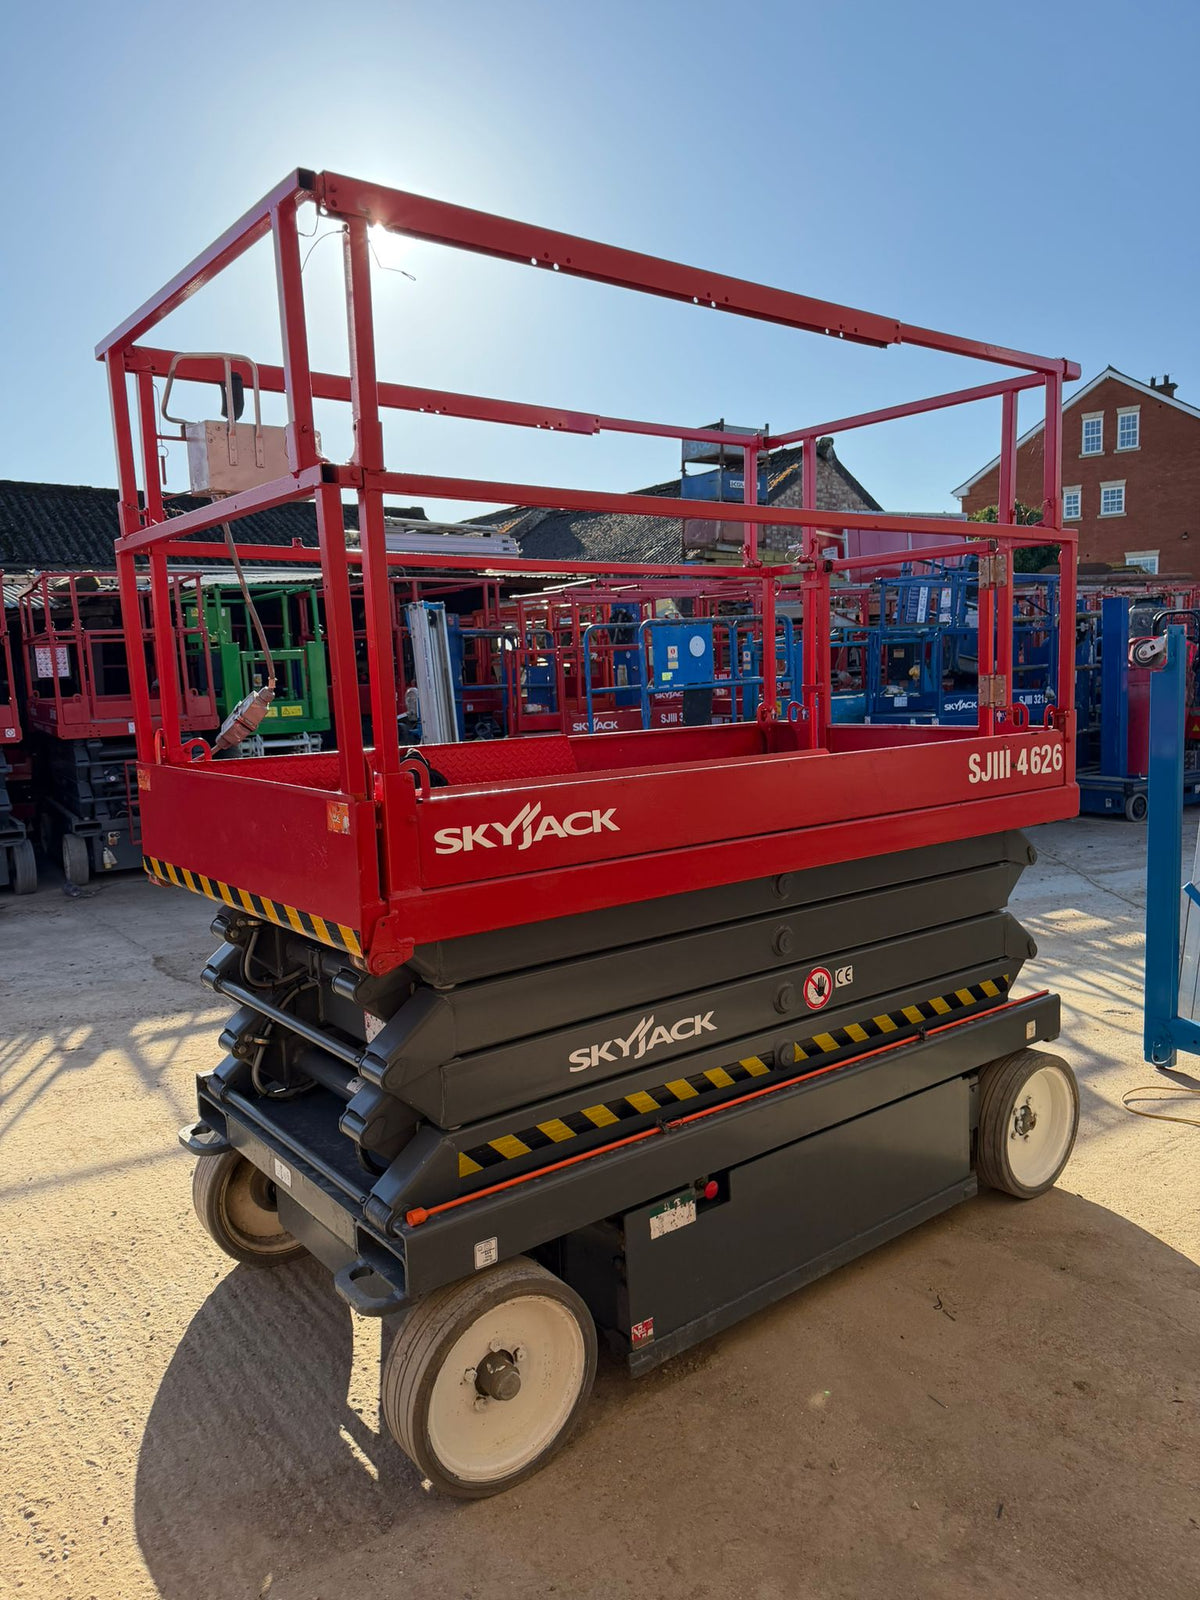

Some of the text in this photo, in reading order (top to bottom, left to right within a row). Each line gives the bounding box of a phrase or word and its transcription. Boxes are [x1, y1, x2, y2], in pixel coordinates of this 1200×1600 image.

[654, 690, 684, 700] SKYJAC
[944, 699, 977, 711] SKYJACK
[968, 743, 1063, 784] SJIII 4626
[434, 801, 621, 854] SKYJACK
[568, 1010, 718, 1073] SKYJACK
